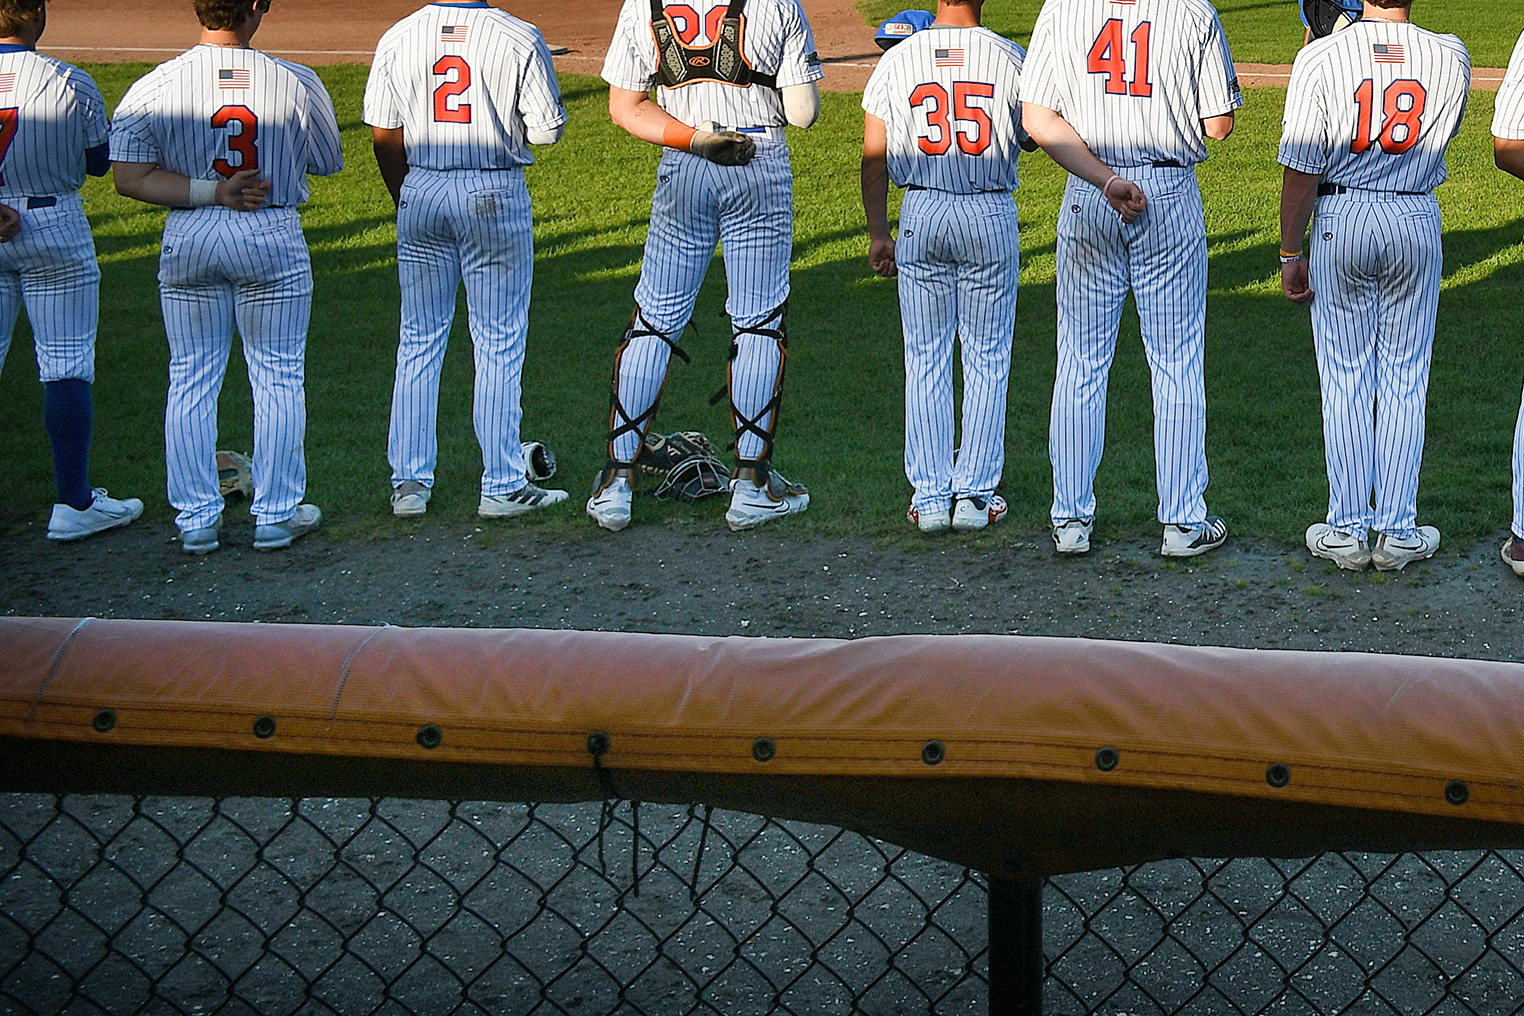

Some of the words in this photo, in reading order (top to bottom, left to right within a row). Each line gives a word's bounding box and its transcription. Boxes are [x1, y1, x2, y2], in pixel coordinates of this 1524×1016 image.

[432, 54, 472, 124] 2
[1086, 17, 1153, 98] 41
[210, 104, 259, 179] 3
[908, 81, 994, 156] 35
[1352, 78, 1427, 155] 18
